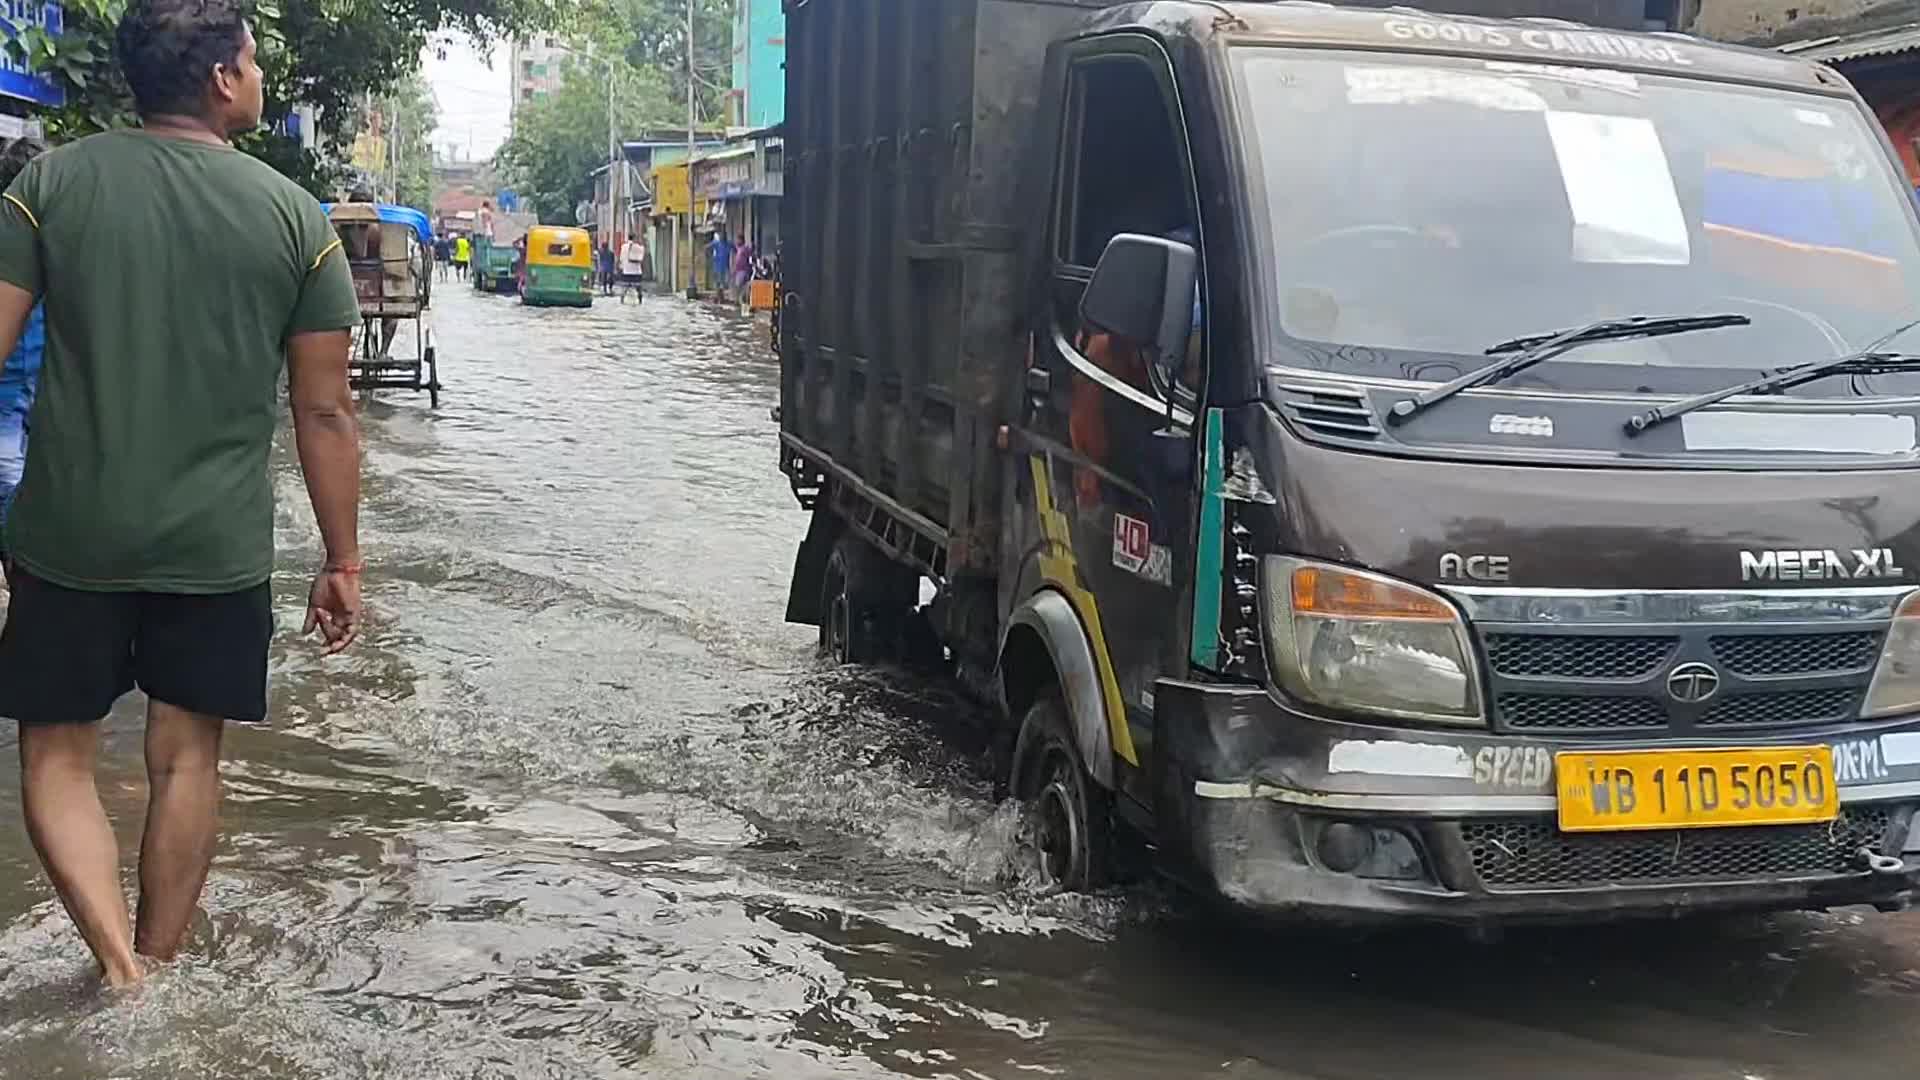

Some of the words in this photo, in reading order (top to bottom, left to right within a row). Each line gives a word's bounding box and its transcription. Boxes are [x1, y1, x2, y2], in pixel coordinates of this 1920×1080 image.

[1440, 553, 1509, 581] ACE
[1740, 550, 1849, 581] MEGA
[1852, 548, 1904, 578] XL
[1475, 746, 1552, 787] SPEED
[1588, 767, 1636, 815] WB
[1731, 762, 1824, 809] 5050
